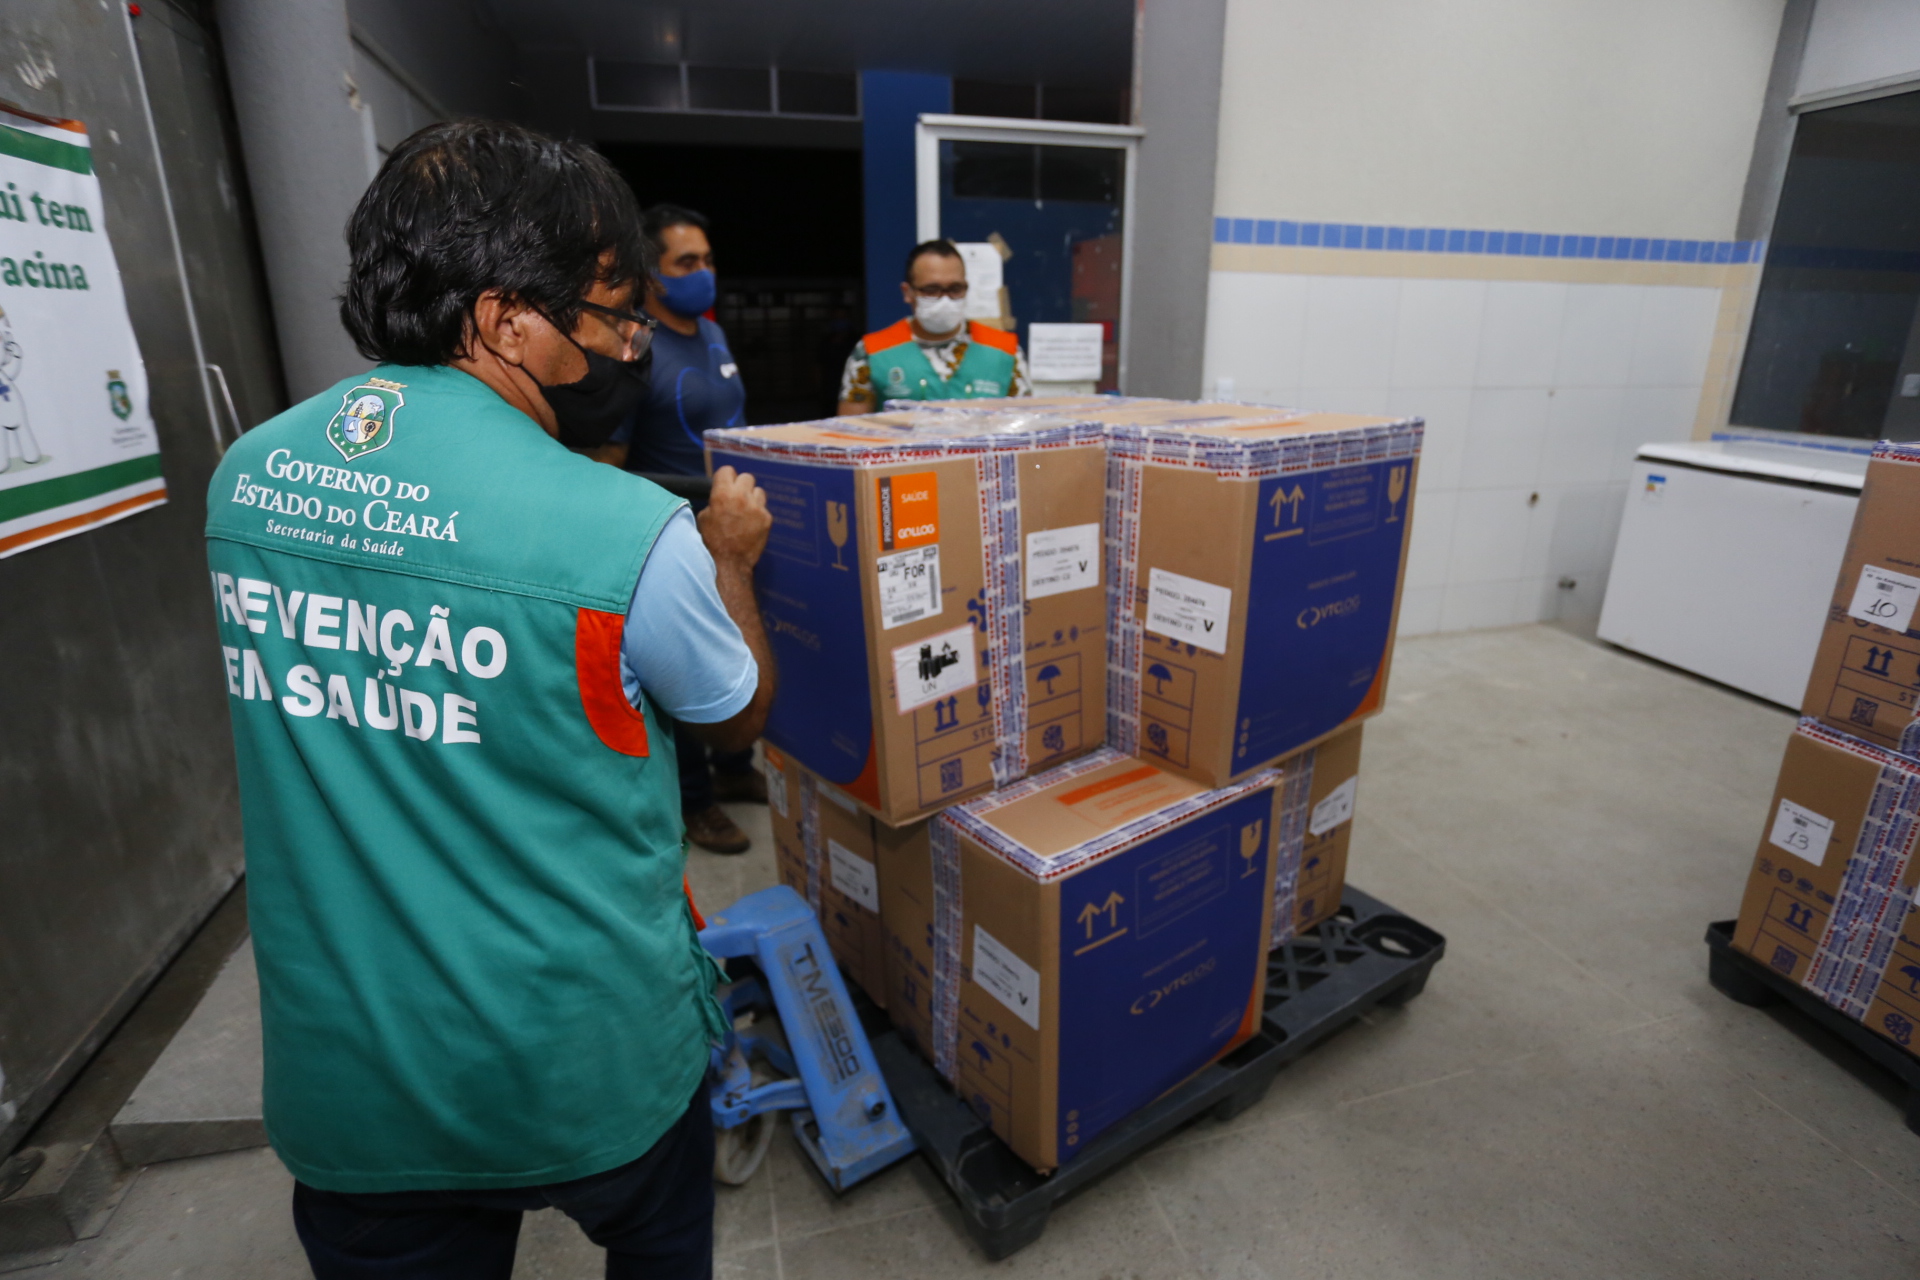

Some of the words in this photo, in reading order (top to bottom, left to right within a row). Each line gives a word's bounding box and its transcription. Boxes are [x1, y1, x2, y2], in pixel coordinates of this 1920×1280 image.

[30, 190, 94, 233] tem
[266, 448, 392, 497] GOVERNO
[394, 481, 430, 502] DO
[231, 473, 322, 521] ESTADO
[325, 505, 357, 526] DO
[362, 499, 459, 543] CEARÁ
[901, 489, 929, 503] SAÚDE
[881, 486, 892, 543] PRIORIDADE
[266, 519, 335, 546] Secretaria
[340, 533, 357, 550] da
[361, 537, 405, 557] Saúde
[904, 563, 925, 580] FOR
[1079, 560, 1088, 572] V
[1864, 598, 1898, 618] 10
[1203, 619, 1214, 632] V
[282, 664, 482, 745] SAÚDE
[1783, 831, 1809, 850] 13
